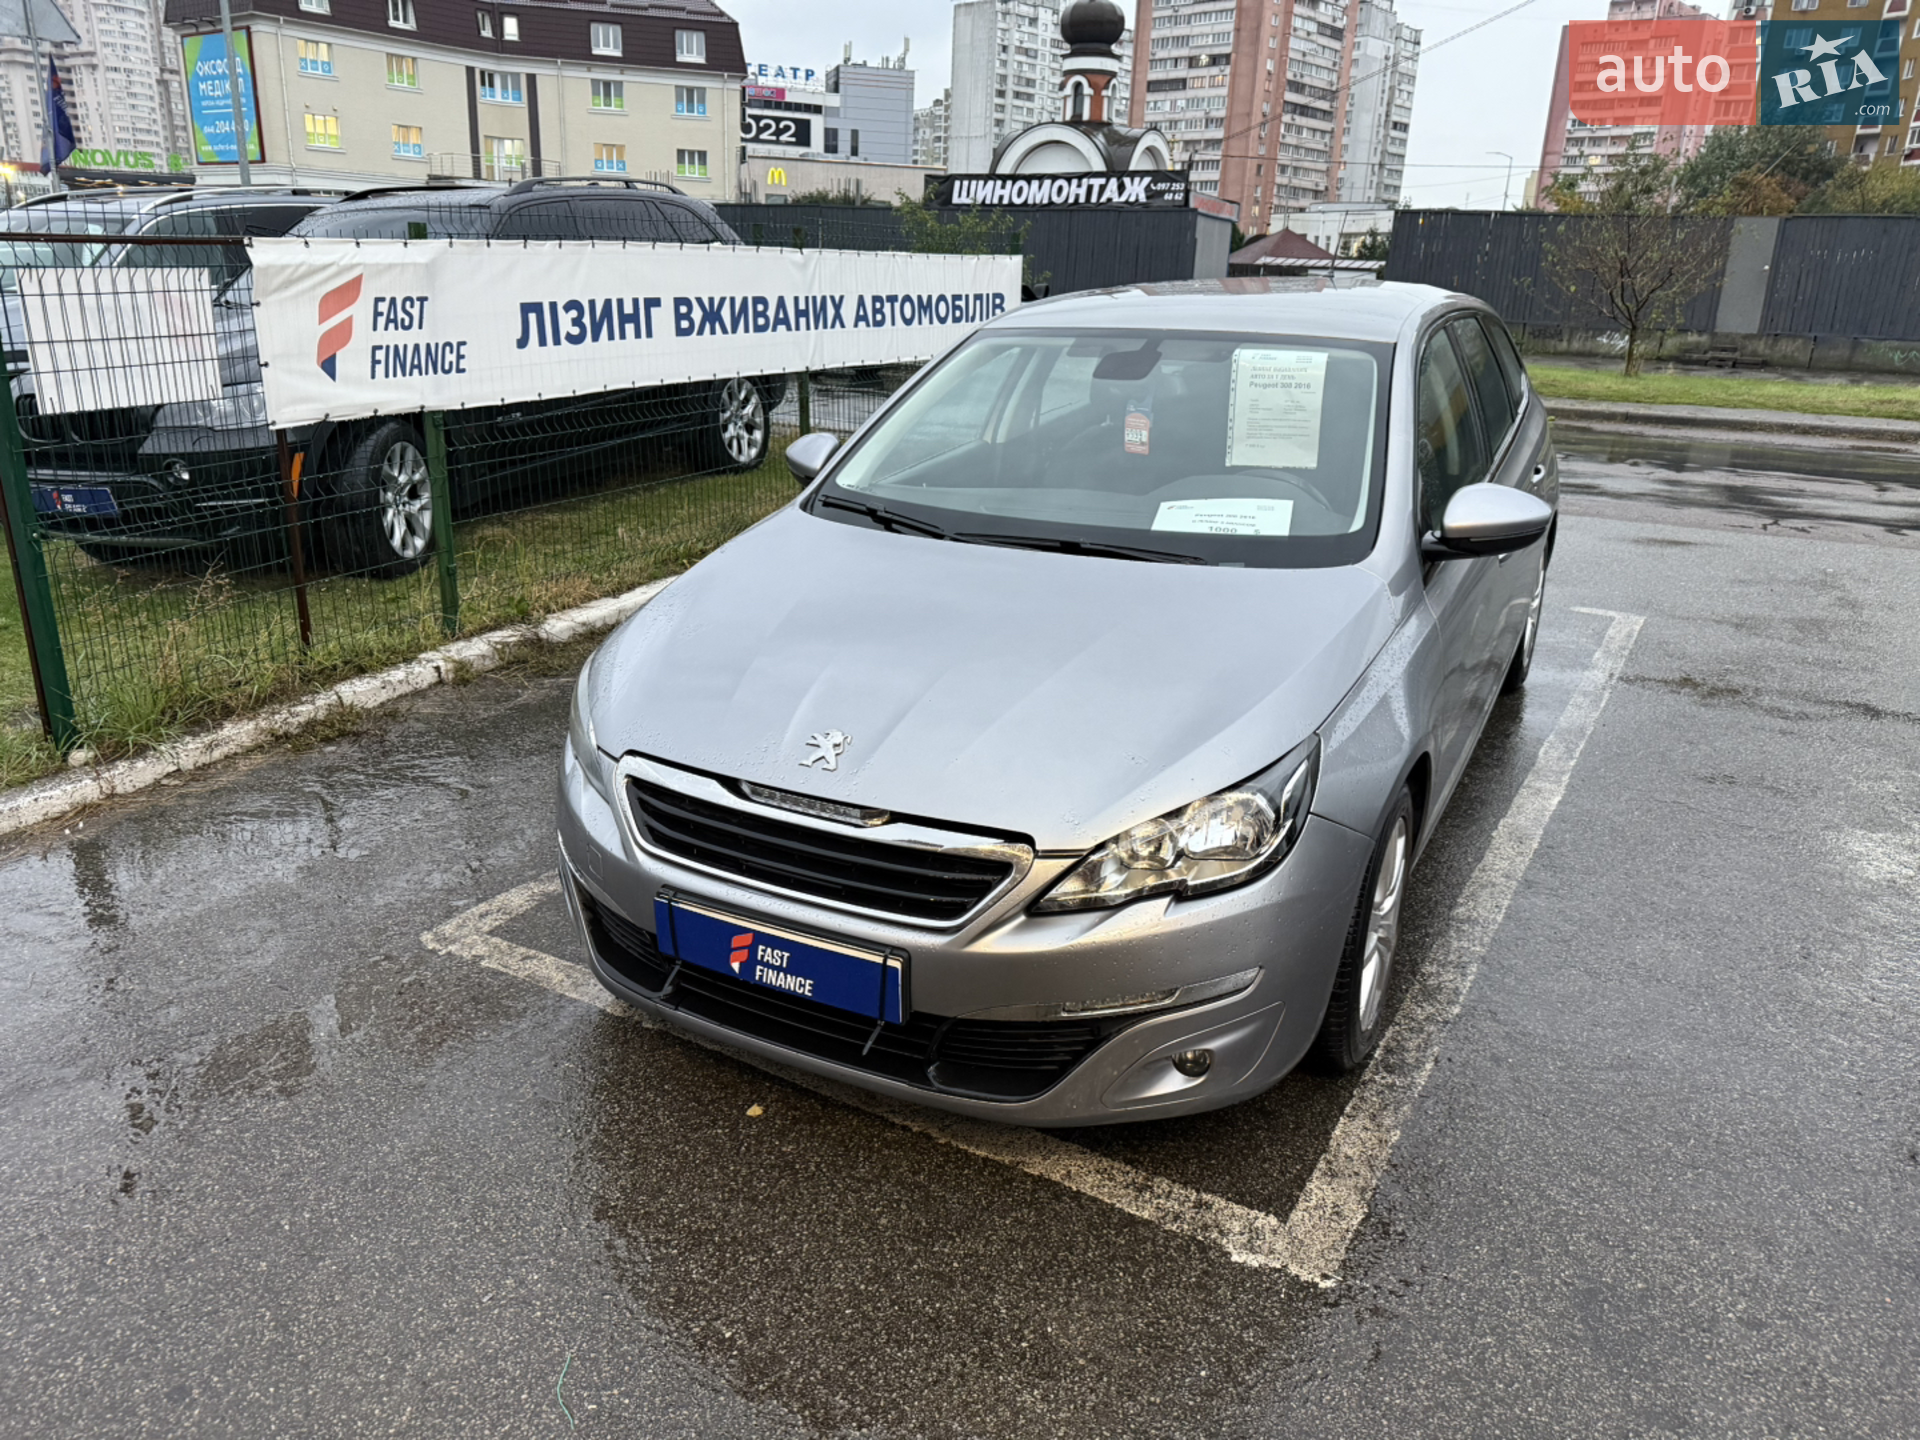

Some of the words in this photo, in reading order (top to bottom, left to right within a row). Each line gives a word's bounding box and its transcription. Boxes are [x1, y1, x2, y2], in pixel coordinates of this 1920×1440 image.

[196, 56, 243, 76] ОКСФОД
[198, 77, 245, 97] МЕДІКЛ
[72, 149, 155, 169] NOVUS
[951, 177, 1152, 204] ШИНОМОНТАЖ
[372, 296, 429, 331] FAST
[516, 296, 662, 349] ЛІЗИНГ
[673, 294, 846, 337] ВЖИВАНИХ
[853, 292, 1006, 328] АВТОМОБІЛІВ
[370, 341, 467, 379] FINANCE
[1249, 381, 1278, 390] Peugeot
[1208, 526, 1238, 534] 1000
[757, 945, 790, 968] FAST
[755, 965, 814, 996] FINANCE
